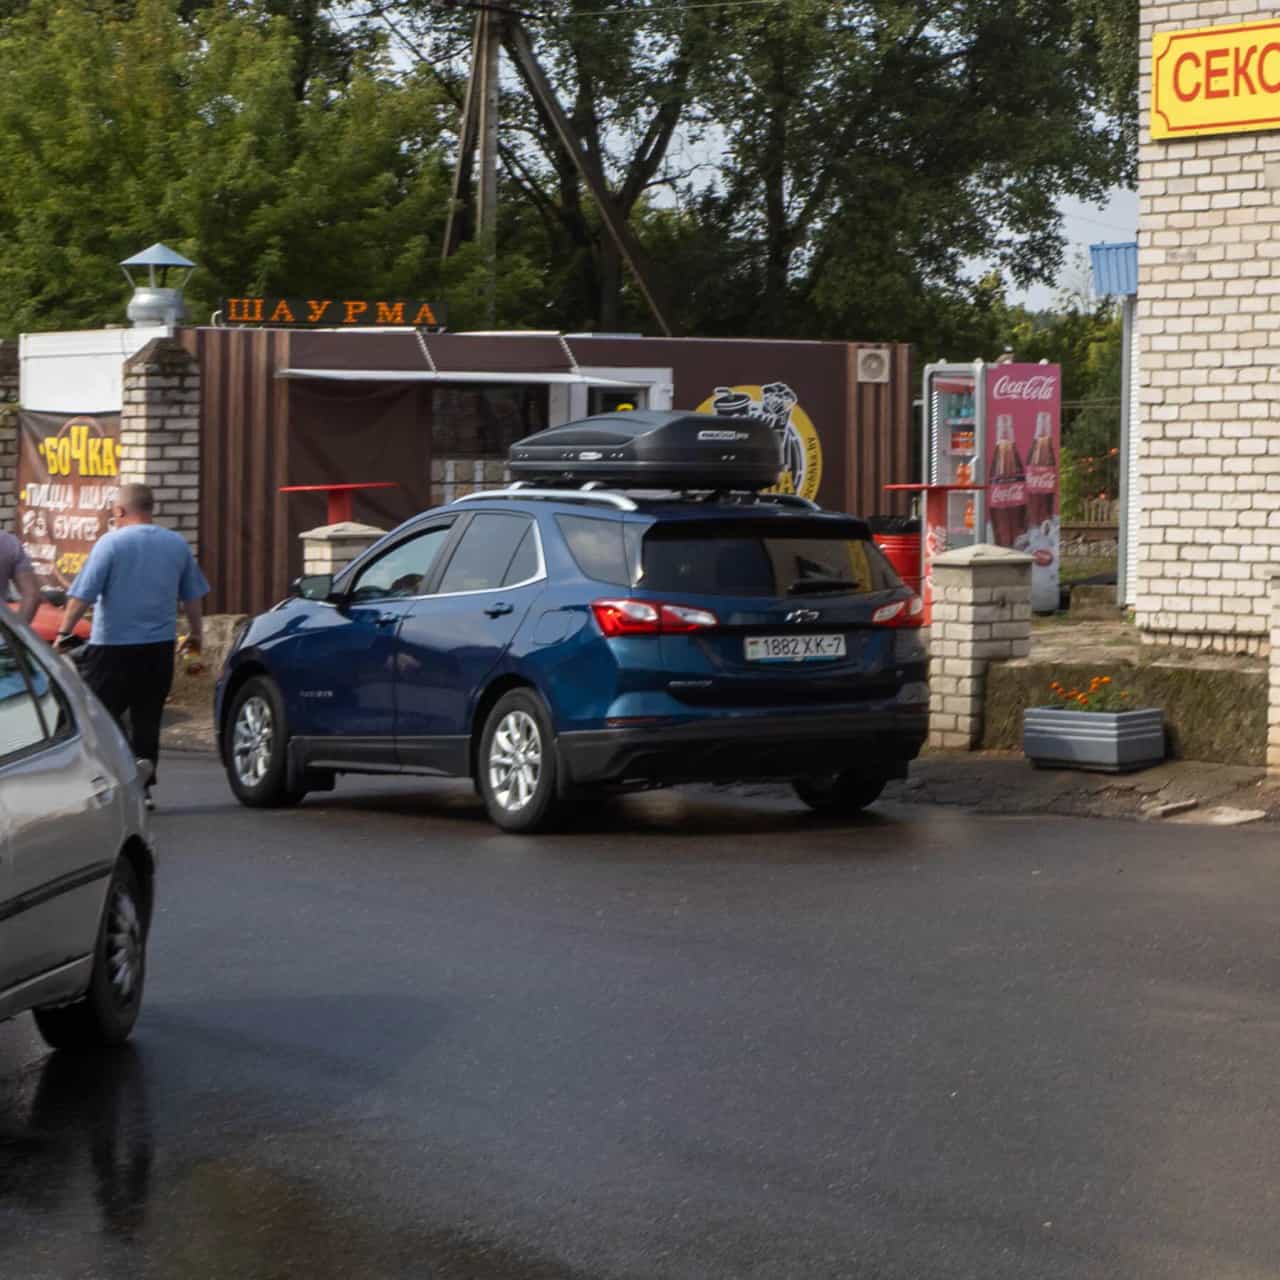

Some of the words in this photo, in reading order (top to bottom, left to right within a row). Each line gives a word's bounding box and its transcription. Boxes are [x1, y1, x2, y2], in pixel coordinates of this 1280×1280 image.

[227, 297, 438, 326] ШАУРМА
[44, 425, 118, 477] БОЧКА
[764, 637, 800, 656] 1882
